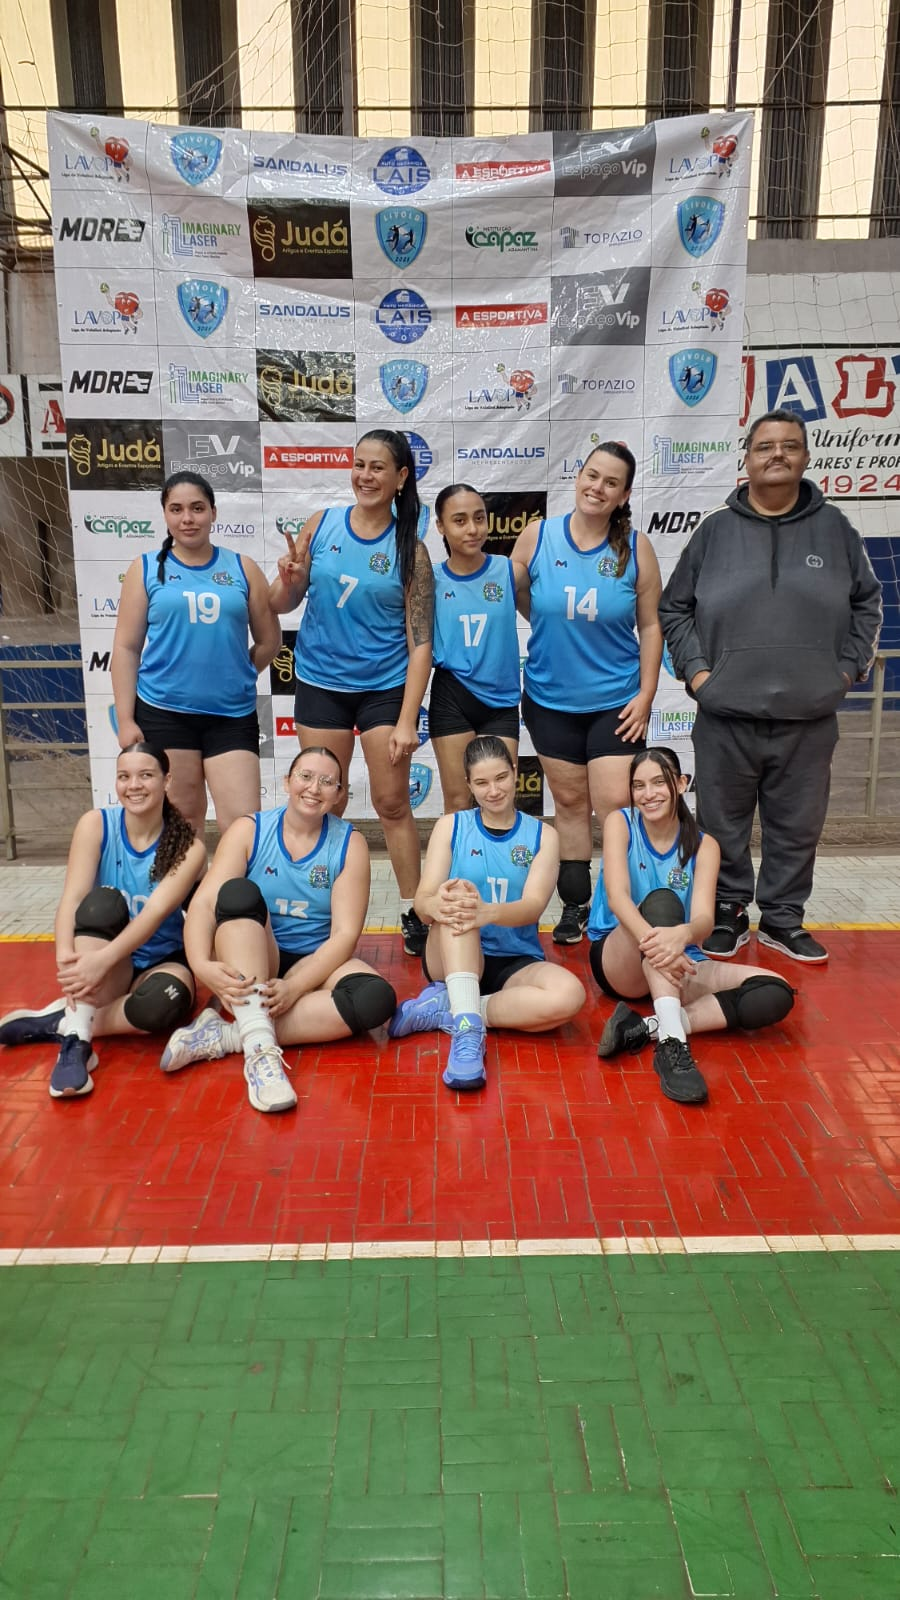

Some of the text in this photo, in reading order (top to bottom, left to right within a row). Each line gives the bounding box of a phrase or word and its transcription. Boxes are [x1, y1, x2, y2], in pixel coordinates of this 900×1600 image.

[253, 156, 348, 176] SANDALUS
[372, 167, 432, 184] LAIS
[182, 222, 241, 236] IMAGINARY
[281, 219, 348, 247] Judá
[183, 235, 217, 247] LASER
[584, 229, 643, 245] TOPAZIO
[259, 304, 350, 318] SANDALUS
[375, 309, 432, 324] LAIS
[461, 309, 543, 321] A ESPORTIVA
[188, 371, 248, 384] IMAGINARY
[582, 379, 636, 390] TOPAZIO
[189, 383, 223, 394] LASER
[97, 437, 161, 462] Judá
[457, 447, 545, 460] SANDALUS
[672, 441, 731, 453] IMAGINARY
[269, 452, 349, 463] A ESPORTIVA
[672, 453, 704, 464] LASER
[856, 456, 866, 469] E
[820, 474, 900, 494] 1924
[488, 509, 543, 534] Jud
[209, 524, 255, 534] OPAZIO
[336, 574, 359, 609] 7
[182, 591, 220, 624] 19
[563, 586, 598, 622] 14
[459, 614, 487, 647] 17
